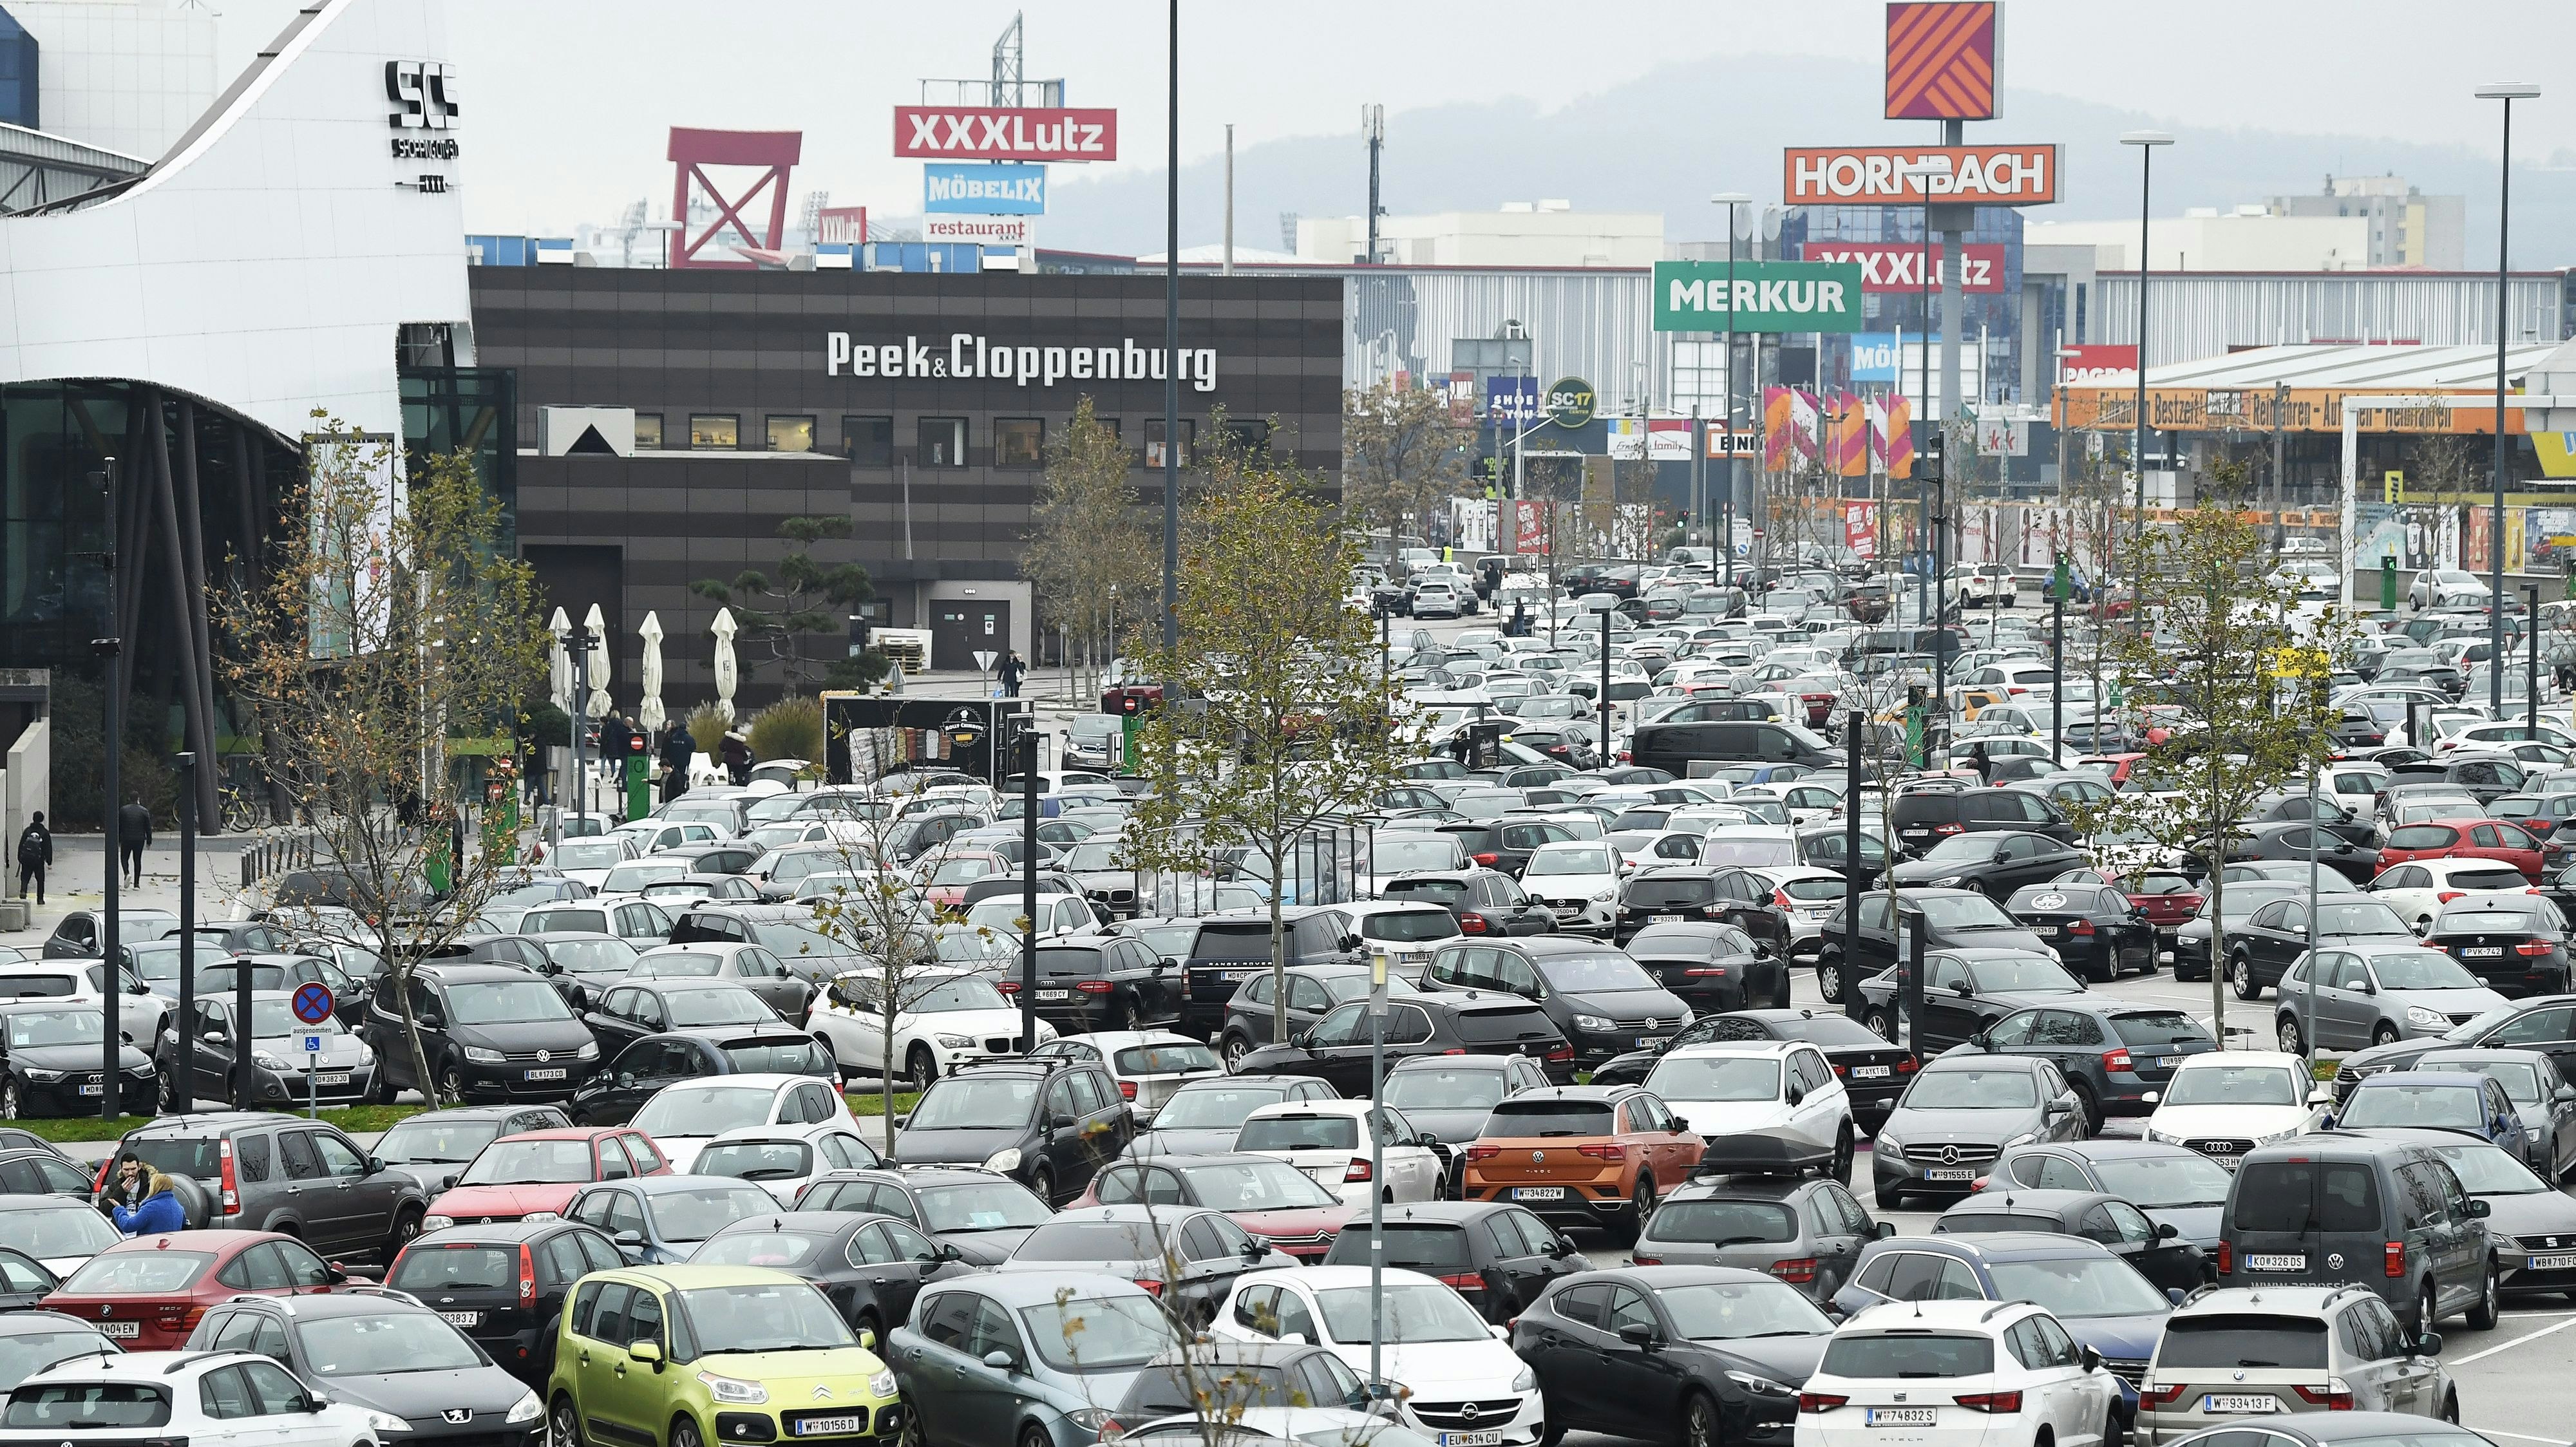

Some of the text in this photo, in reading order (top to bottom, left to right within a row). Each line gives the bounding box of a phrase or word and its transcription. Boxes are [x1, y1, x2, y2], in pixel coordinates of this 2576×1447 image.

[908, 114, 1104, 152] XXXLutz
[1795, 153, 2045, 196] HORNBACH
[928, 173, 1042, 203] MÖBELIX
[929, 221, 1025, 238] restaurant
[1669, 279, 1846, 312] MERKUR
[1551, 392, 1592, 406] SC17
[1530, 1189, 1554, 1197] 34822
[2254, 1256, 2302, 1267] KO 326 DS
[2535, 1258, 2546, 1267] WB
[2552, 1258, 2566, 1267] 710
[104, 1323, 135, 1334] 404 EN
[2214, 1398, 2221, 1408] W
[2230, 1398, 2262, 1409] 93413
[1875, 1412, 1883, 1421] W
[1891, 1411, 1924, 1421] 74832
[806, 1421, 812, 1432] W
[820, 1420, 846, 1431] 10156
[1449, 1433, 1498, 1446] EU 614 CU
